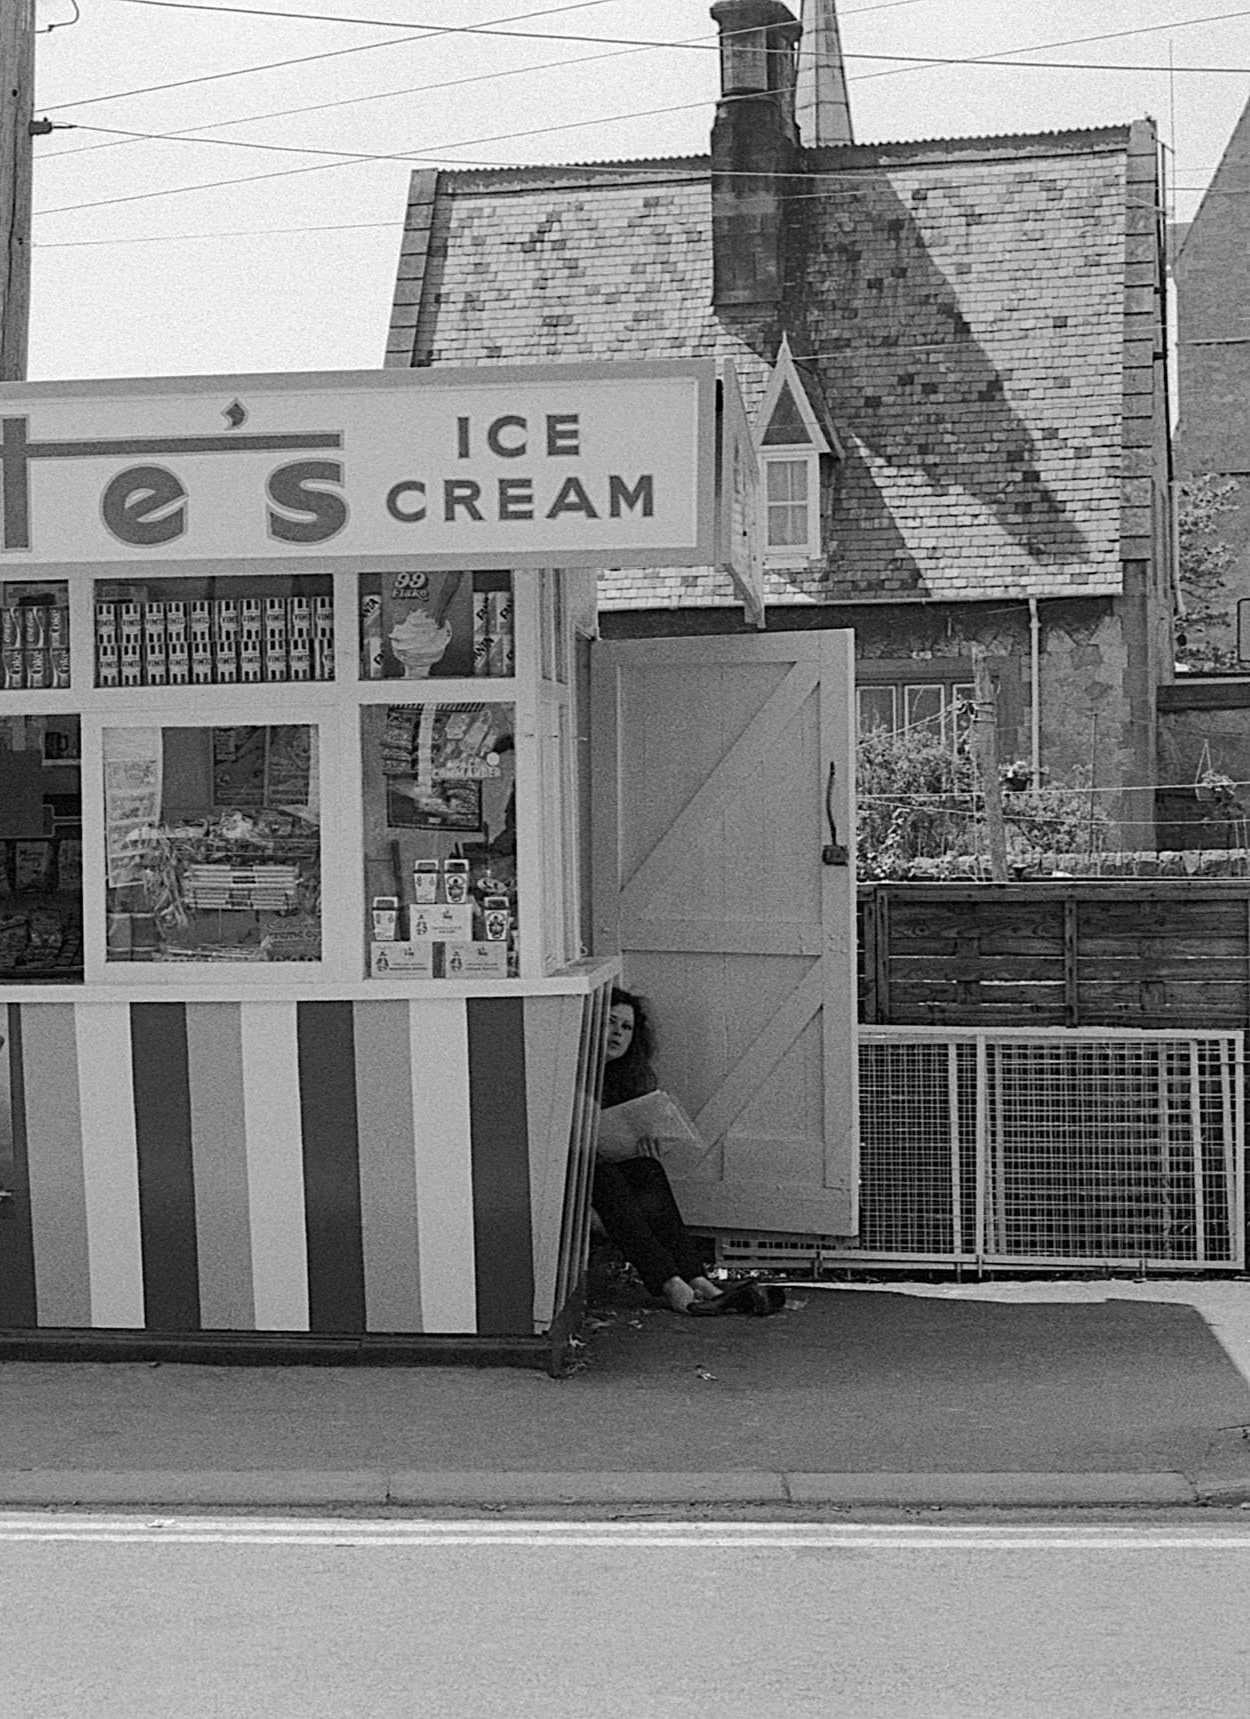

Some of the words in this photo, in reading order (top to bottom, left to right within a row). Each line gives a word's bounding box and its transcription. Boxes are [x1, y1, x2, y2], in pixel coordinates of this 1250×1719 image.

[457, 413, 580, 459] ICE
[386, 474, 654, 523] CREAM
[393, 572, 429, 589] 99
[49, 610, 60, 636] Coke
[10, 651, 22, 677] Coke
[31, 651, 43, 677] Coke
